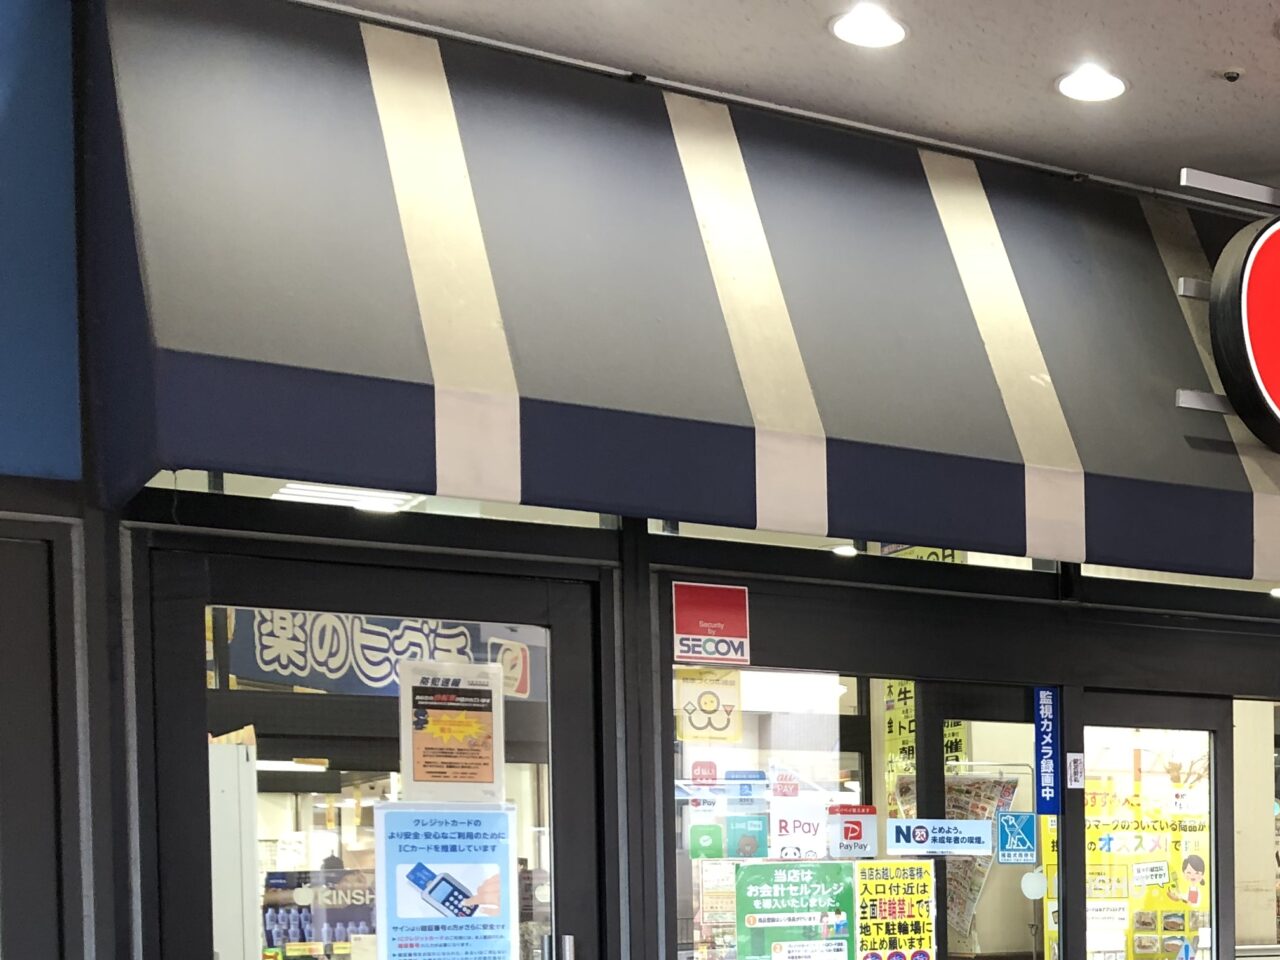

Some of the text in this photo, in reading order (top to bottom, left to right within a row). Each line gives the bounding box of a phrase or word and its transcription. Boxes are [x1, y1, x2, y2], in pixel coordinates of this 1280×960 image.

[699, 621, 724, 630] Security
[679, 637, 745, 657] SECOM
[1039, 690, 1055, 801] 監視カメラ録画中
[413, 819, 482, 827] クレジットカードの
[793, 820, 820, 836] Pay
[931, 826, 963, 835] とめよう。
[839, 842, 867, 851] PayPay
[931, 836, 985, 844] 未成年者の喫煙。
[398, 844, 497, 853] ICカードを推進しています
[774, 869, 814, 882] 当店は
[860, 867, 931, 880] 当店お越しのお客様へ
[746, 883, 845, 898] お会計セルフレジ
[860, 883, 929, 895] 入口付近は
[753, 898, 840, 909] を導入いたしました。
[860, 898, 933, 919] 全面駐輪禁止です
[859, 921, 933, 936] 地下駐輪場に
[859, 936, 932, 952] お止め願います！
